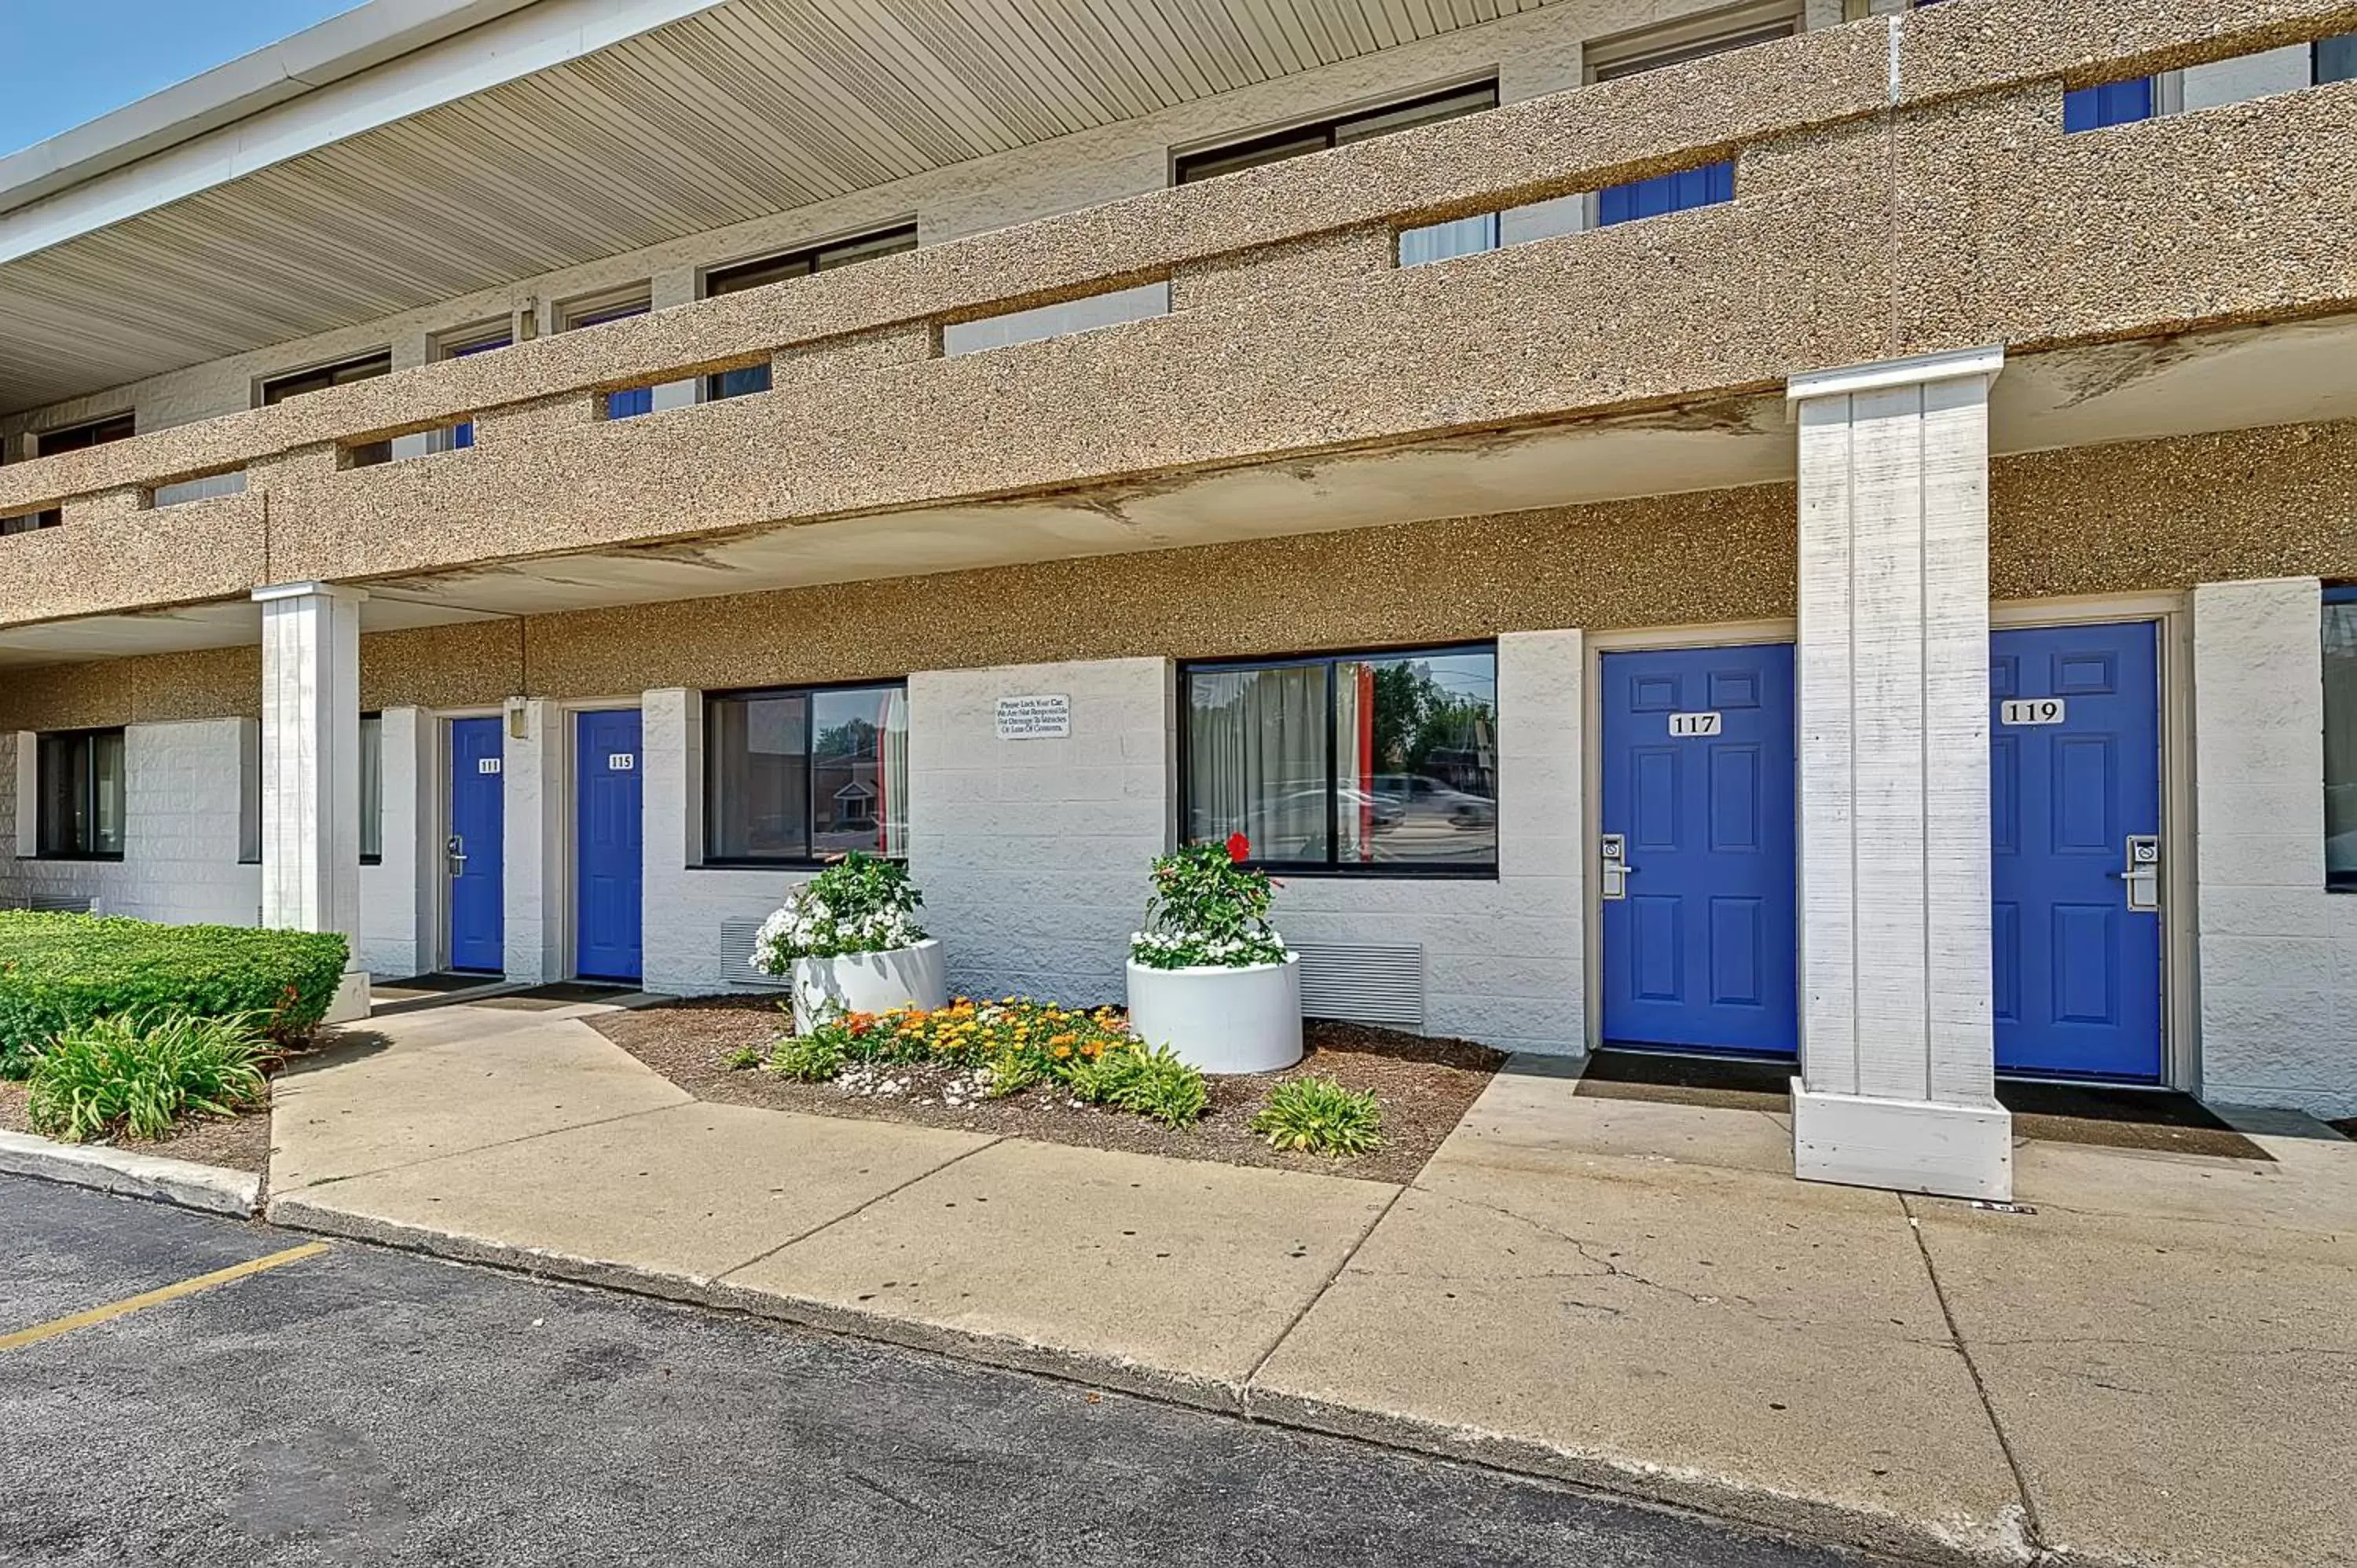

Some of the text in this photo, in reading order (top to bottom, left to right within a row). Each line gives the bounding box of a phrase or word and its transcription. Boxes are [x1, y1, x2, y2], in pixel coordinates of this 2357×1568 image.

[1031, 707, 1068, 716] Responsible
[2010, 702, 2058, 722] 119
[1009, 717, 1032, 727] Damage
[1675, 716, 1715, 733] 117
[612, 756, 631, 768] 115
